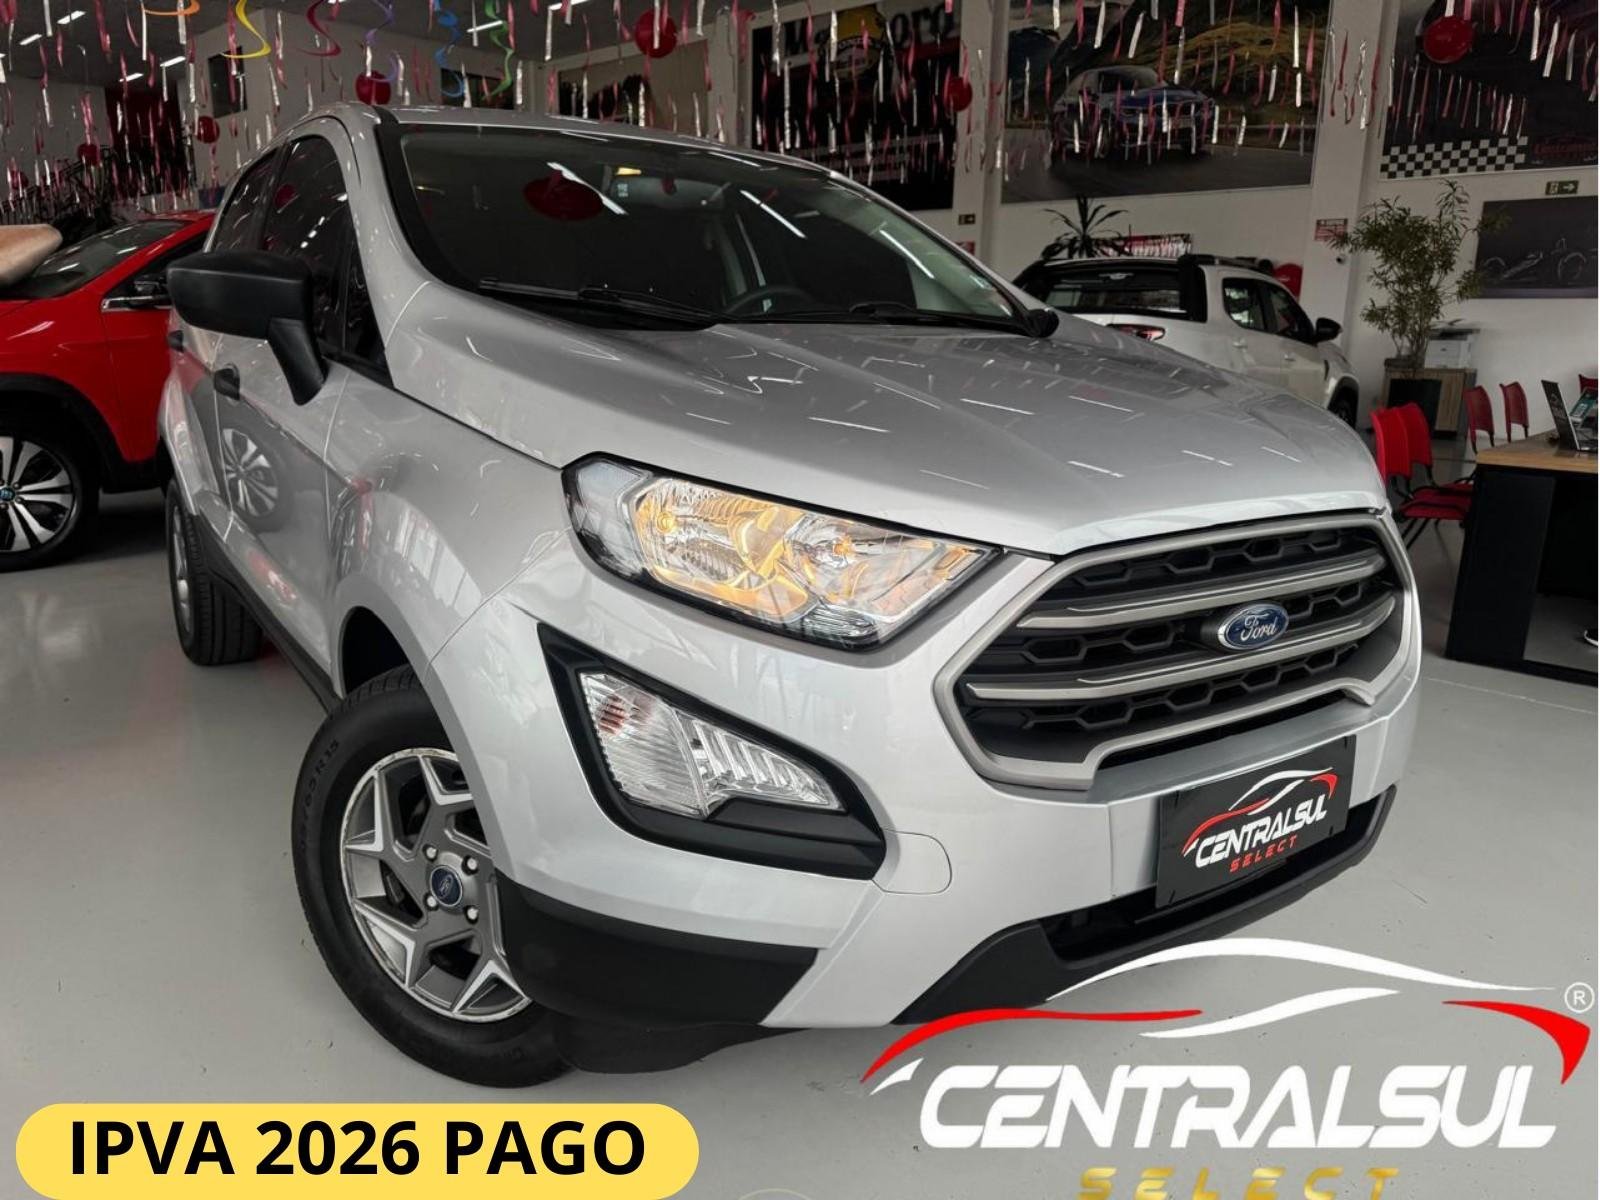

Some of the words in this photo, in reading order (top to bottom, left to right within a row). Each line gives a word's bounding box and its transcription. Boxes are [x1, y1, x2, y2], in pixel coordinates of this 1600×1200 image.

[1240, 613, 1278, 642] Ford
[1195, 794, 1327, 868] CENTRALSUL
[1229, 834, 1298, 873] SELECT
